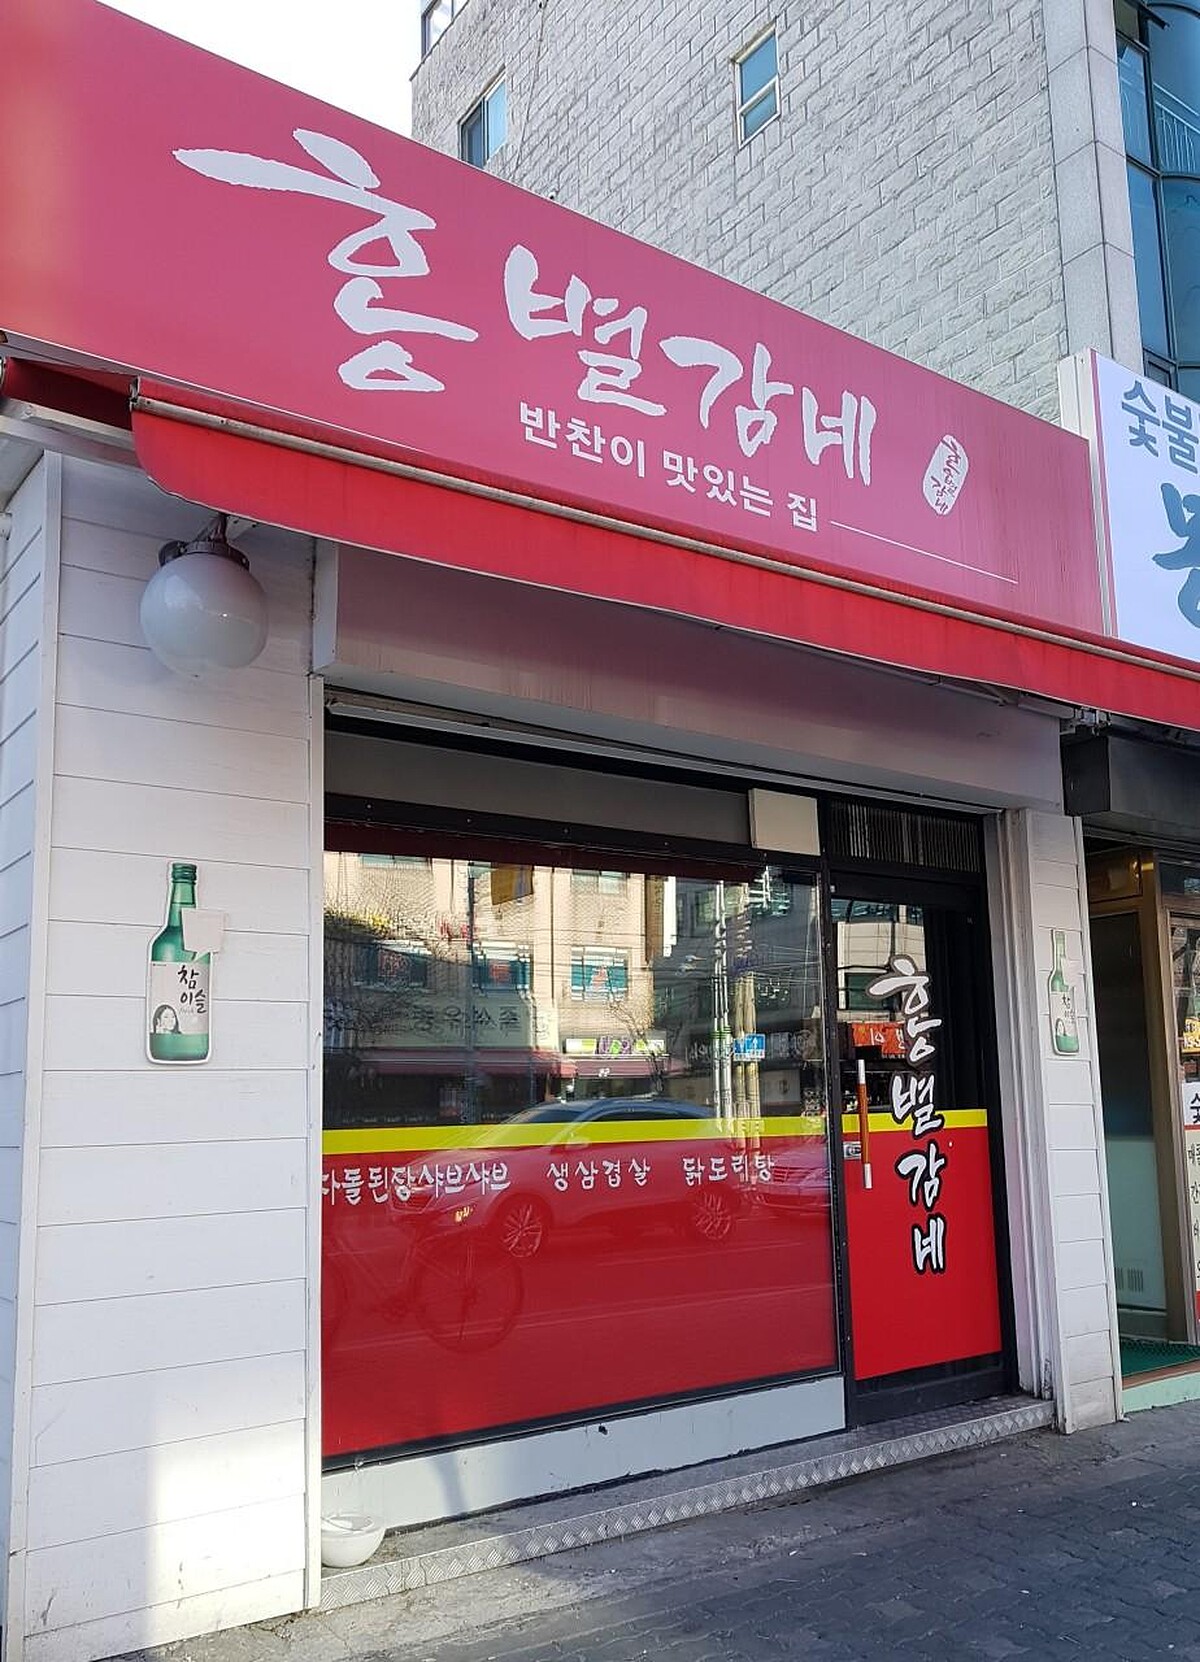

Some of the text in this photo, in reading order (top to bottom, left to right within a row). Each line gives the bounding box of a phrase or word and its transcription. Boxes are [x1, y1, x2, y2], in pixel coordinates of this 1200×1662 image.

[520, 401, 818, 532] 반찬이 맛있는 집
[1120, 380, 1200, 475] 숯불
[546, 1158, 651, 1192] 생삼겹살
[682, 1154, 775, 1187] 닭도리탕
